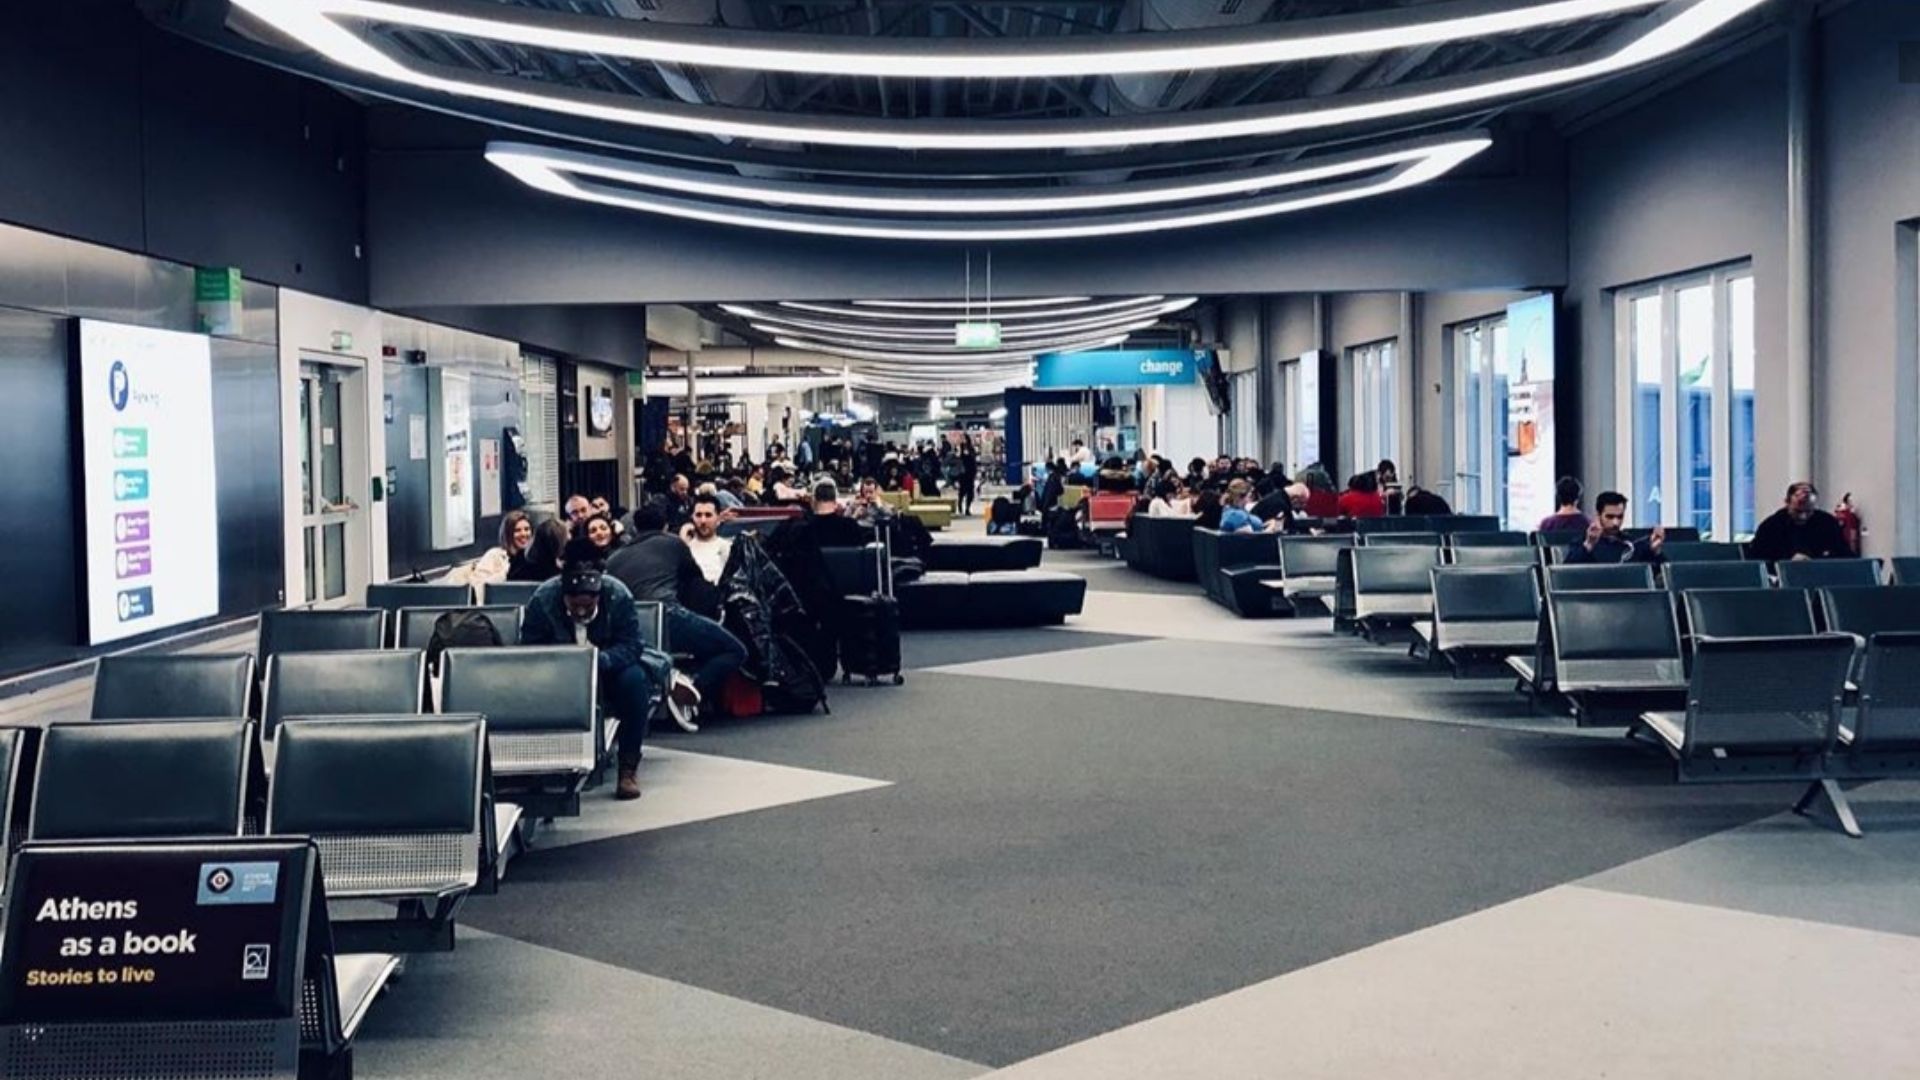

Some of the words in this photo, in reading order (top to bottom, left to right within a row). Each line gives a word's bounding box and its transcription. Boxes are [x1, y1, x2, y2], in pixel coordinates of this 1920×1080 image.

[1140, 358, 1183, 376] change
[36, 896, 137, 921] Athens
[60, 936, 92, 956] as
[98, 936, 116, 955] a
[123, 929, 197, 955] book
[26, 968, 93, 985] Stories
[97, 967, 118, 984] to
[121, 966, 155, 983] live
